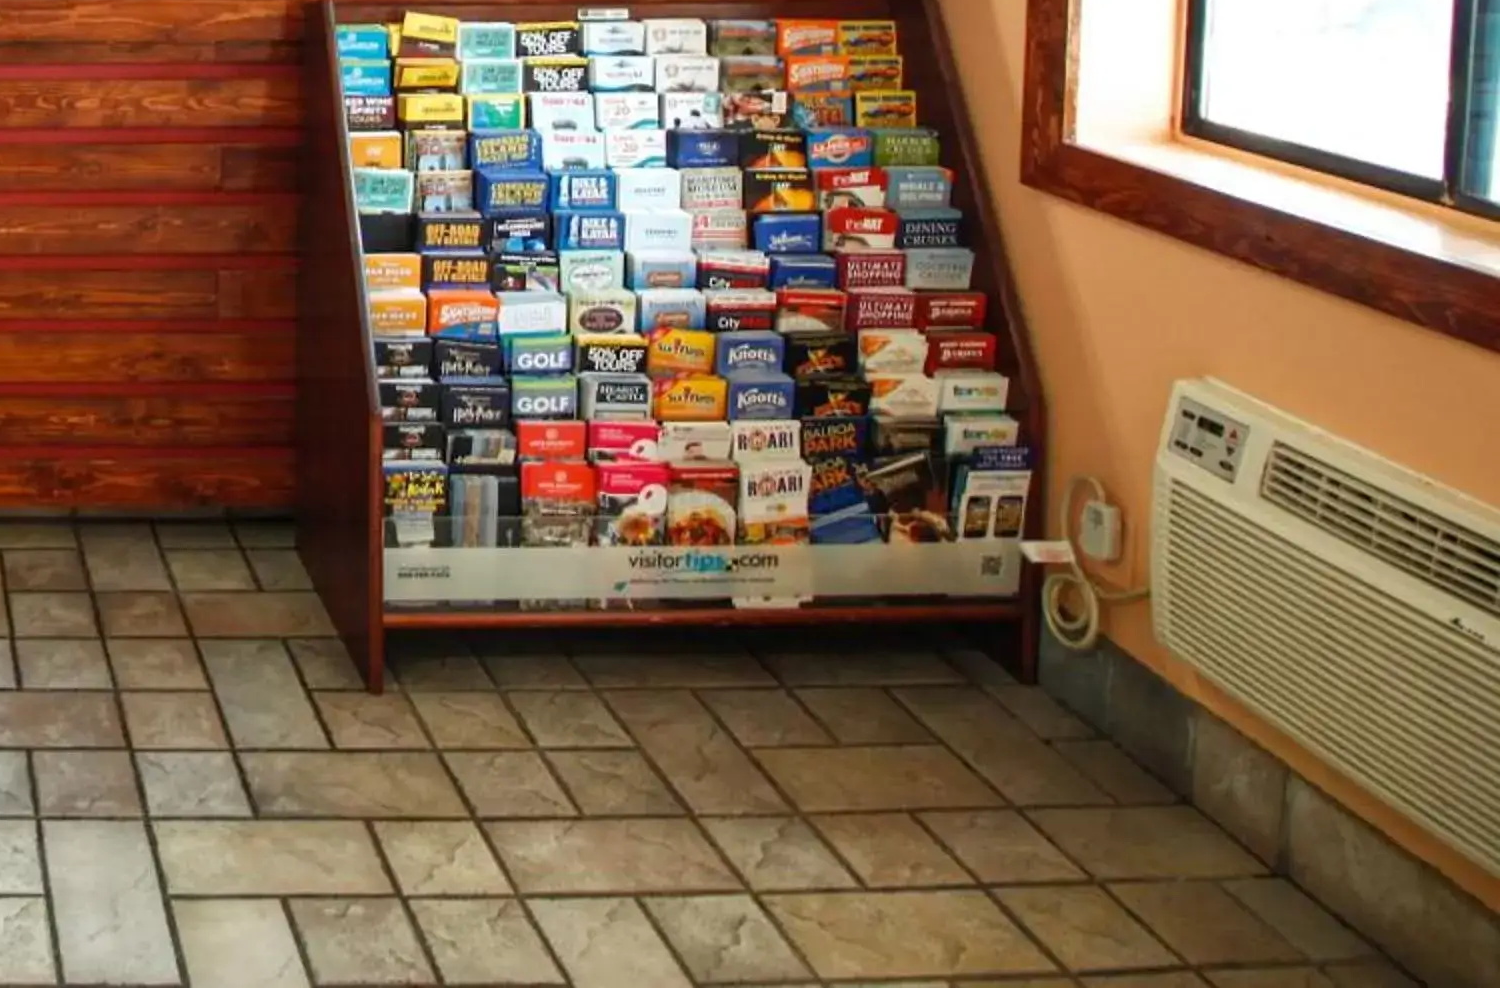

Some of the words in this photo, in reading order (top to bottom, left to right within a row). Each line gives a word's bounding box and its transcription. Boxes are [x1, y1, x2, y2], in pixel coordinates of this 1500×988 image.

[905, 222, 957, 234] DINING
[847, 270, 902, 280] SHOPPING
[859, 302, 915, 312] ULTIMATE
[859, 311, 914, 321] SHOPPING
[517, 352, 566, 370] GOLF
[587, 347, 618, 362] 50%
[619, 349, 646, 363] OFF
[728, 343, 777, 365] Knott's
[594, 360, 638, 373] TOURS
[516, 396, 570, 413] GOLF
[737, 388, 787, 409] Knott's
[803, 435, 857, 454] PARK
